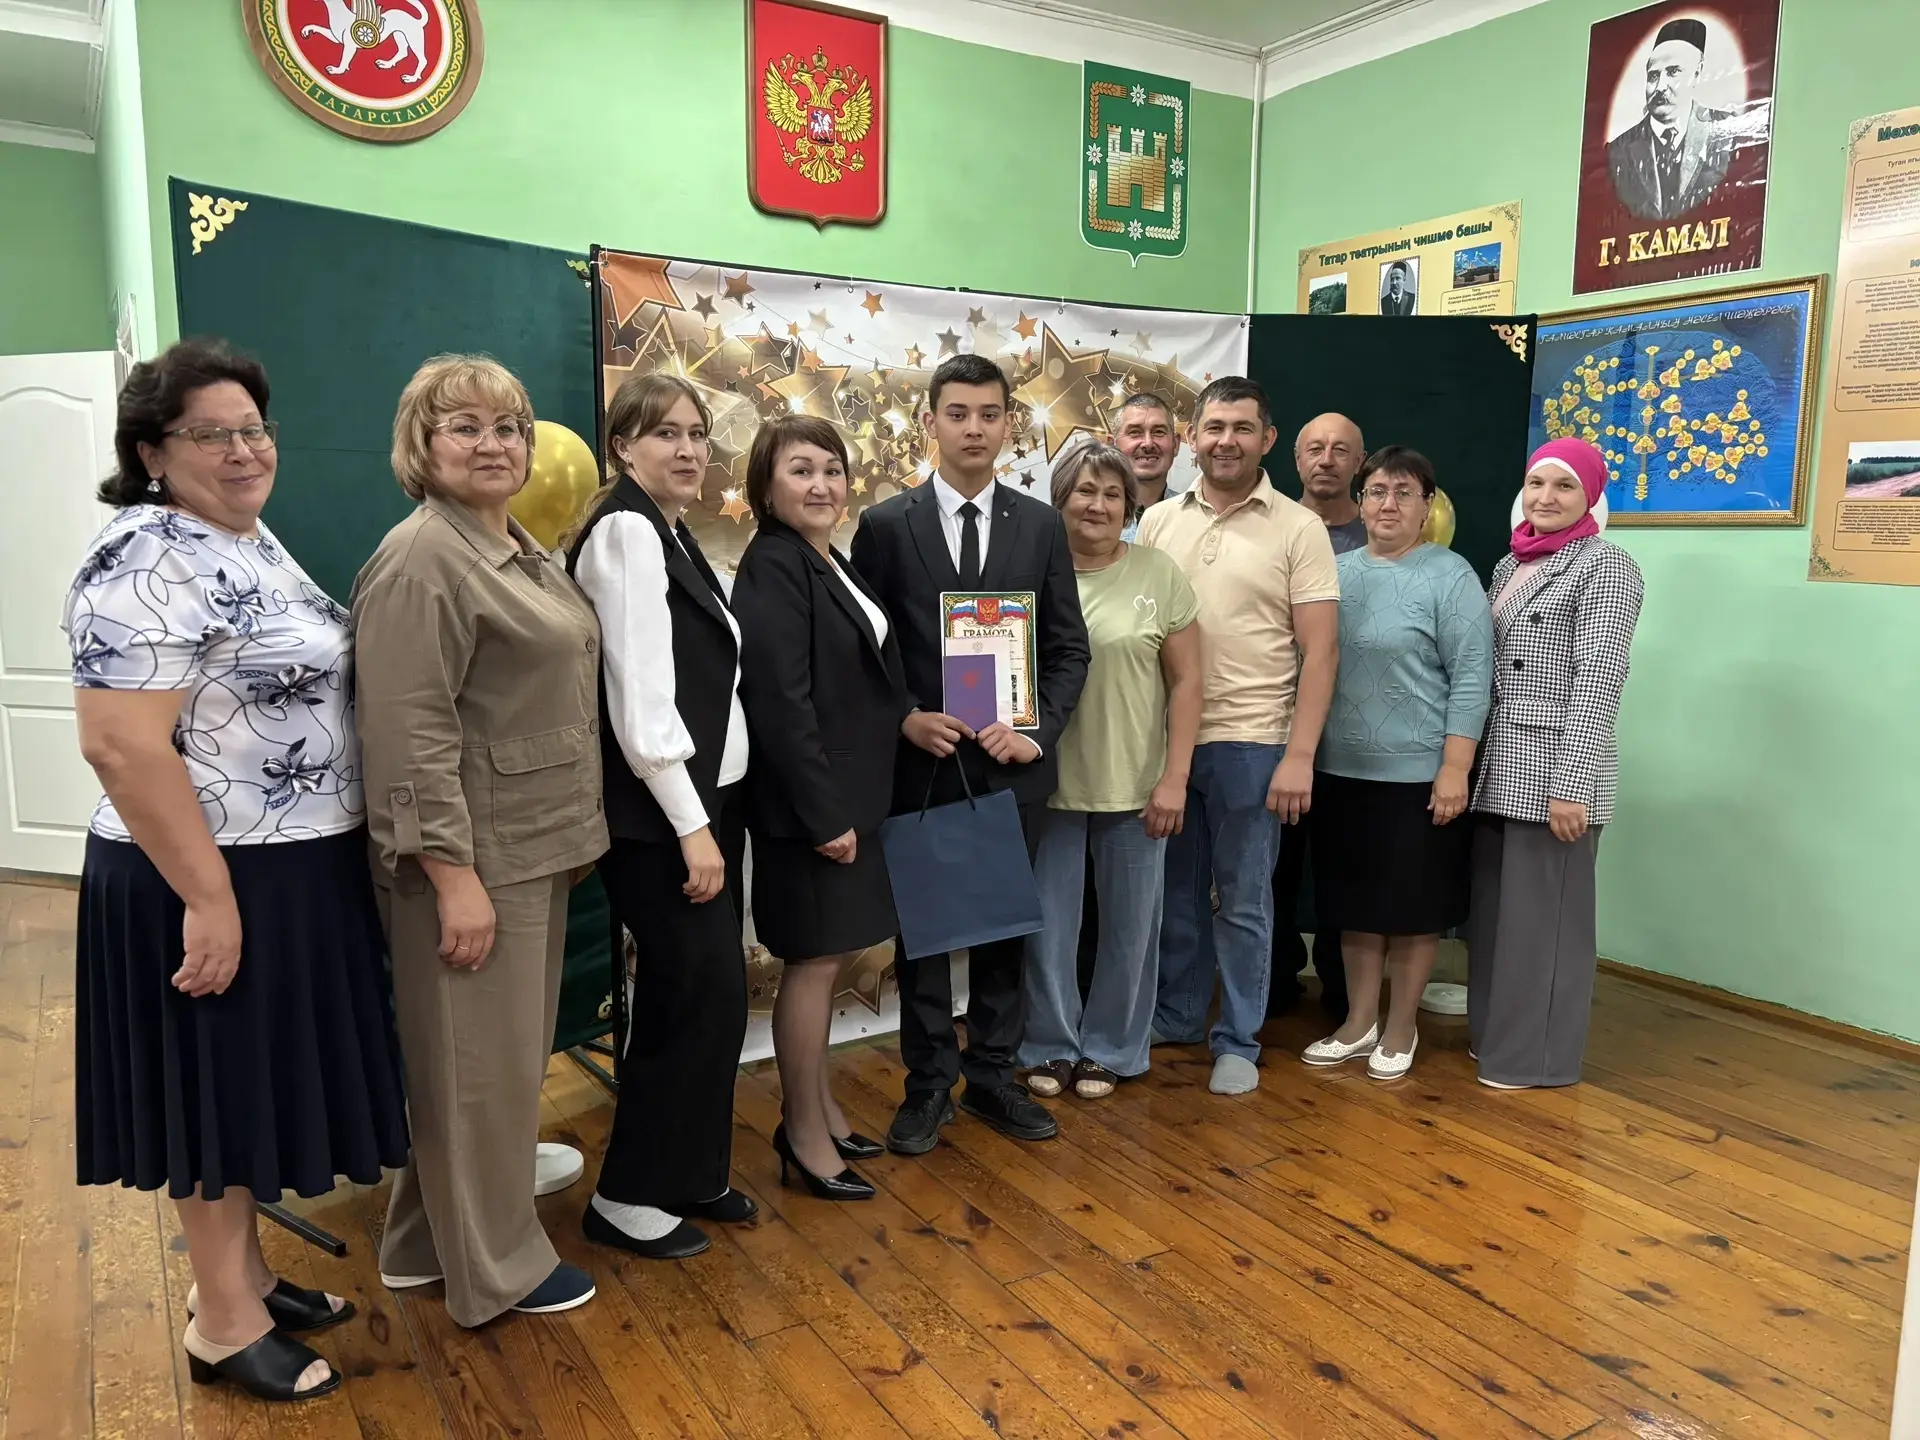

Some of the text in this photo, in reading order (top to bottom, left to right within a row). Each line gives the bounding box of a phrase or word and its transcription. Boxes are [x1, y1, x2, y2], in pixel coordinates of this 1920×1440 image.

[313, 86, 429, 124] ТАТАРСТАН
[1877, 123, 1920, 142] Мөхә
[1318, 220, 1493, 267] Татар театрының чишмә башы
[1598, 216, 1731, 267] Г. КАМАЛ
[963, 628, 1015, 638] ГРАМОТА
